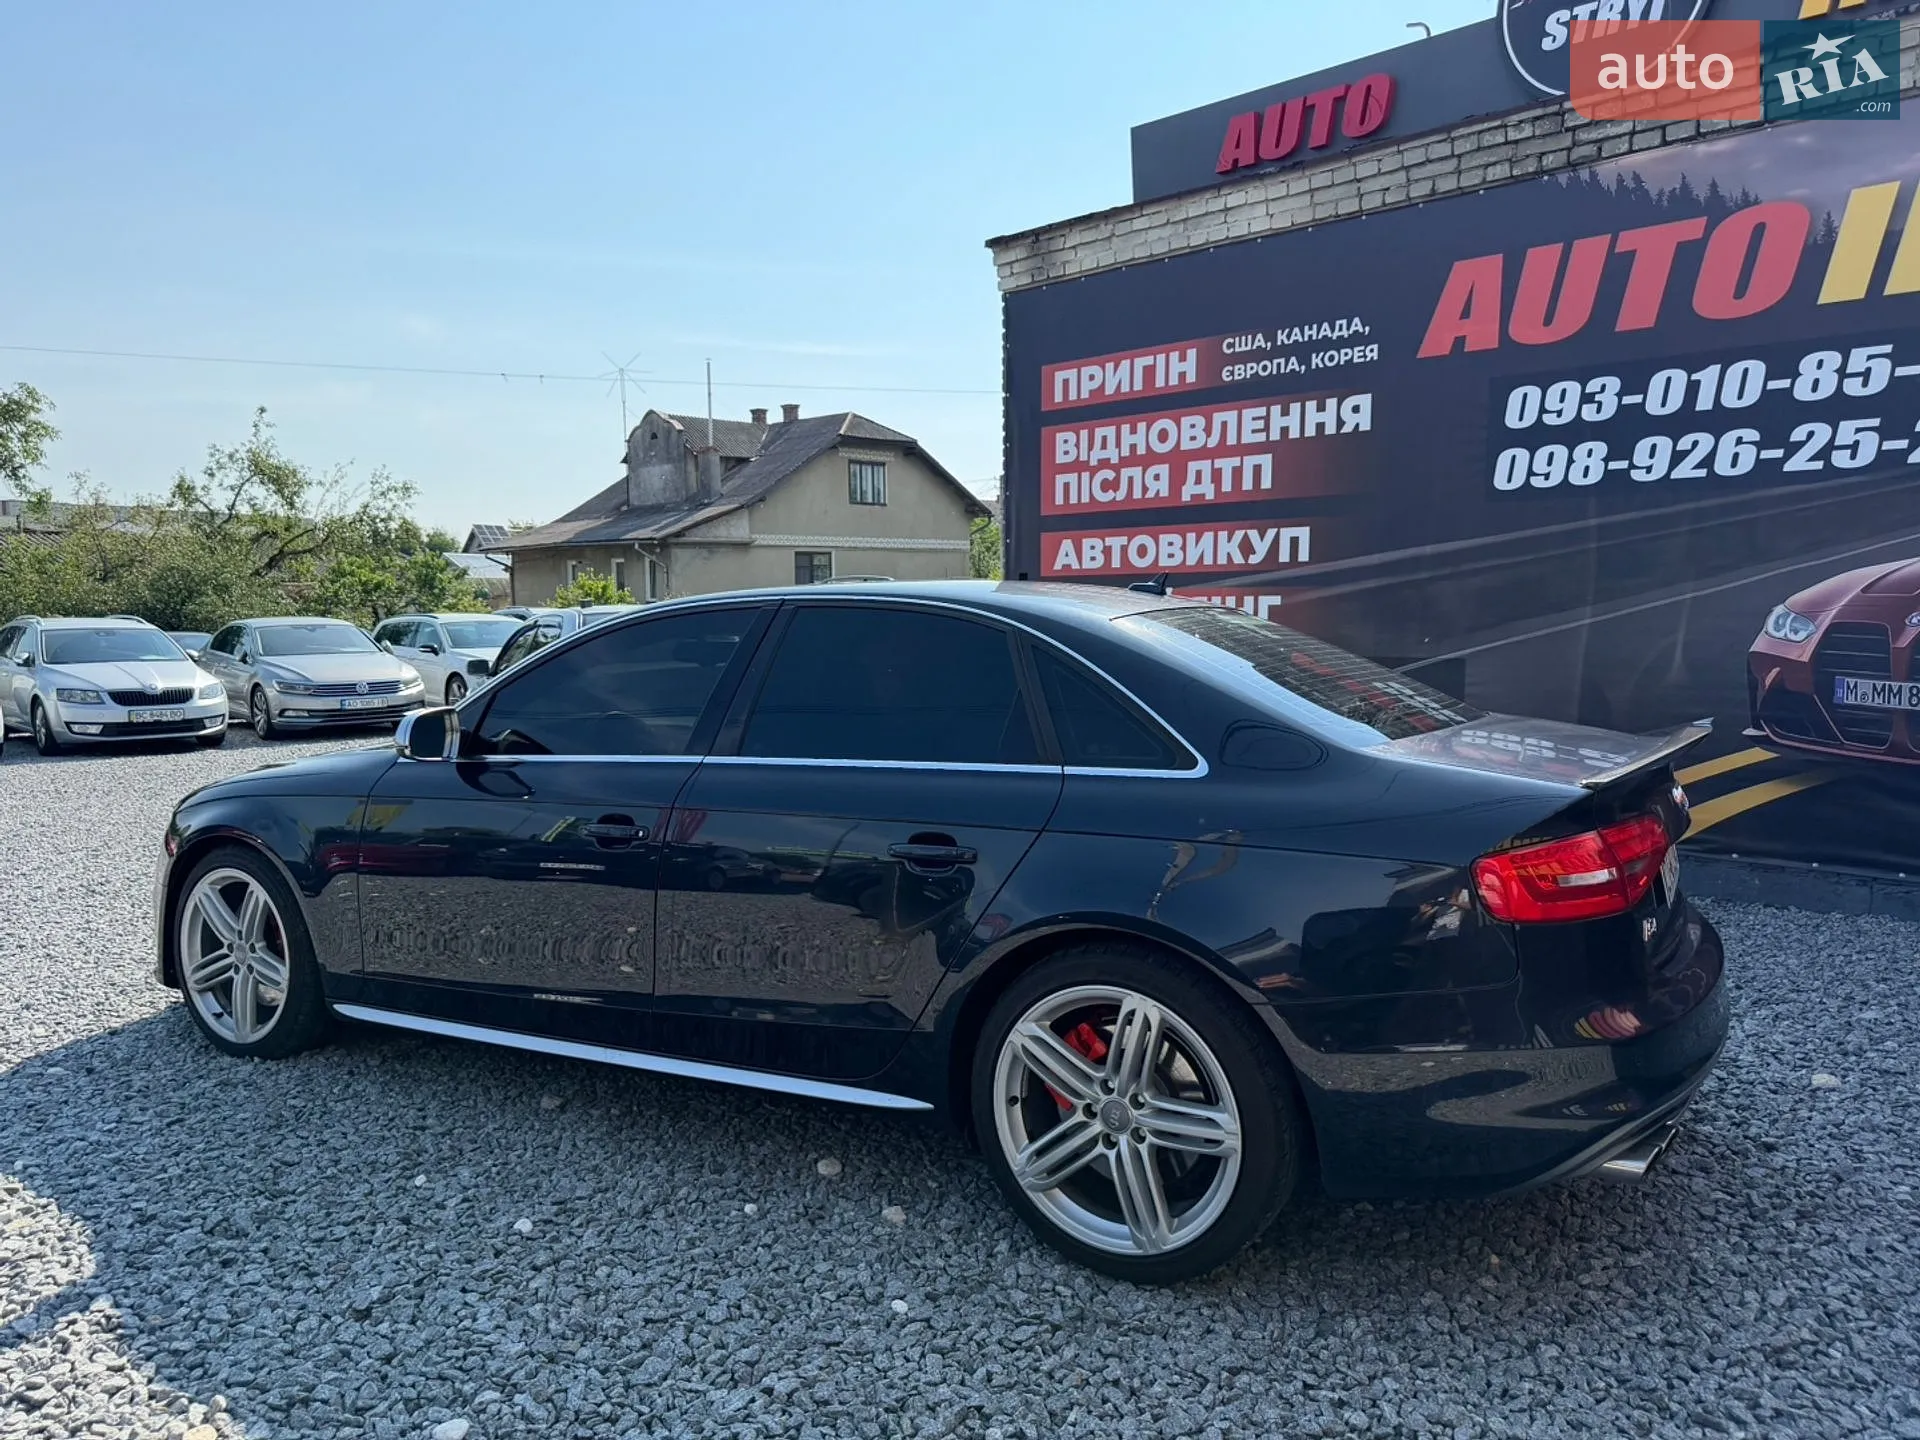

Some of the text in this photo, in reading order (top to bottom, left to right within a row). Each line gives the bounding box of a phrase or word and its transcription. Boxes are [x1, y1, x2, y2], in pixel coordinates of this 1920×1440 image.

[1215, 73, 1397, 175] AUTO
[1416, 201, 1811, 359] AUTO
[1221, 343, 1379, 382] ЄВРОПА, КОРЕЯ
[1222, 316, 1371, 355] США, КАНАДА,
[1053, 347, 1198, 404] ПРИГІН
[1055, 393, 1373, 466] ВІДНОВЛЕННЯ
[1055, 453, 1273, 506] ПІСЛЯ ДТП
[1053, 526, 1311, 571] АВТОВИКУП
